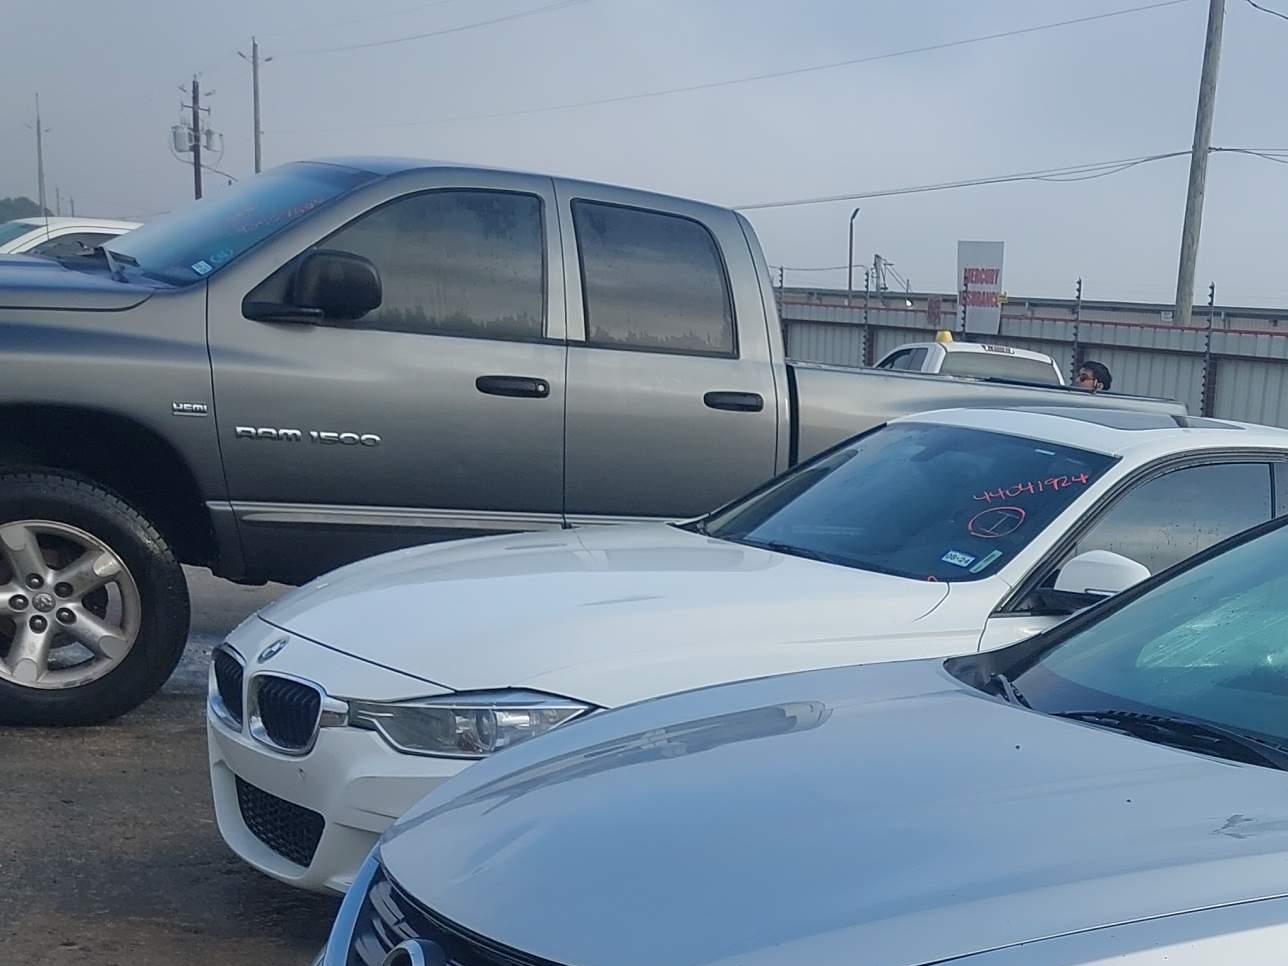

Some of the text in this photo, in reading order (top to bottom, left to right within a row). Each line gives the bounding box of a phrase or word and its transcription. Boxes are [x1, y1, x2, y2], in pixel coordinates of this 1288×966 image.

[964, 267, 1000, 285] MERCURY
[172, 401, 208, 413] HEMI
[235, 425, 383, 448] RAM 1500
